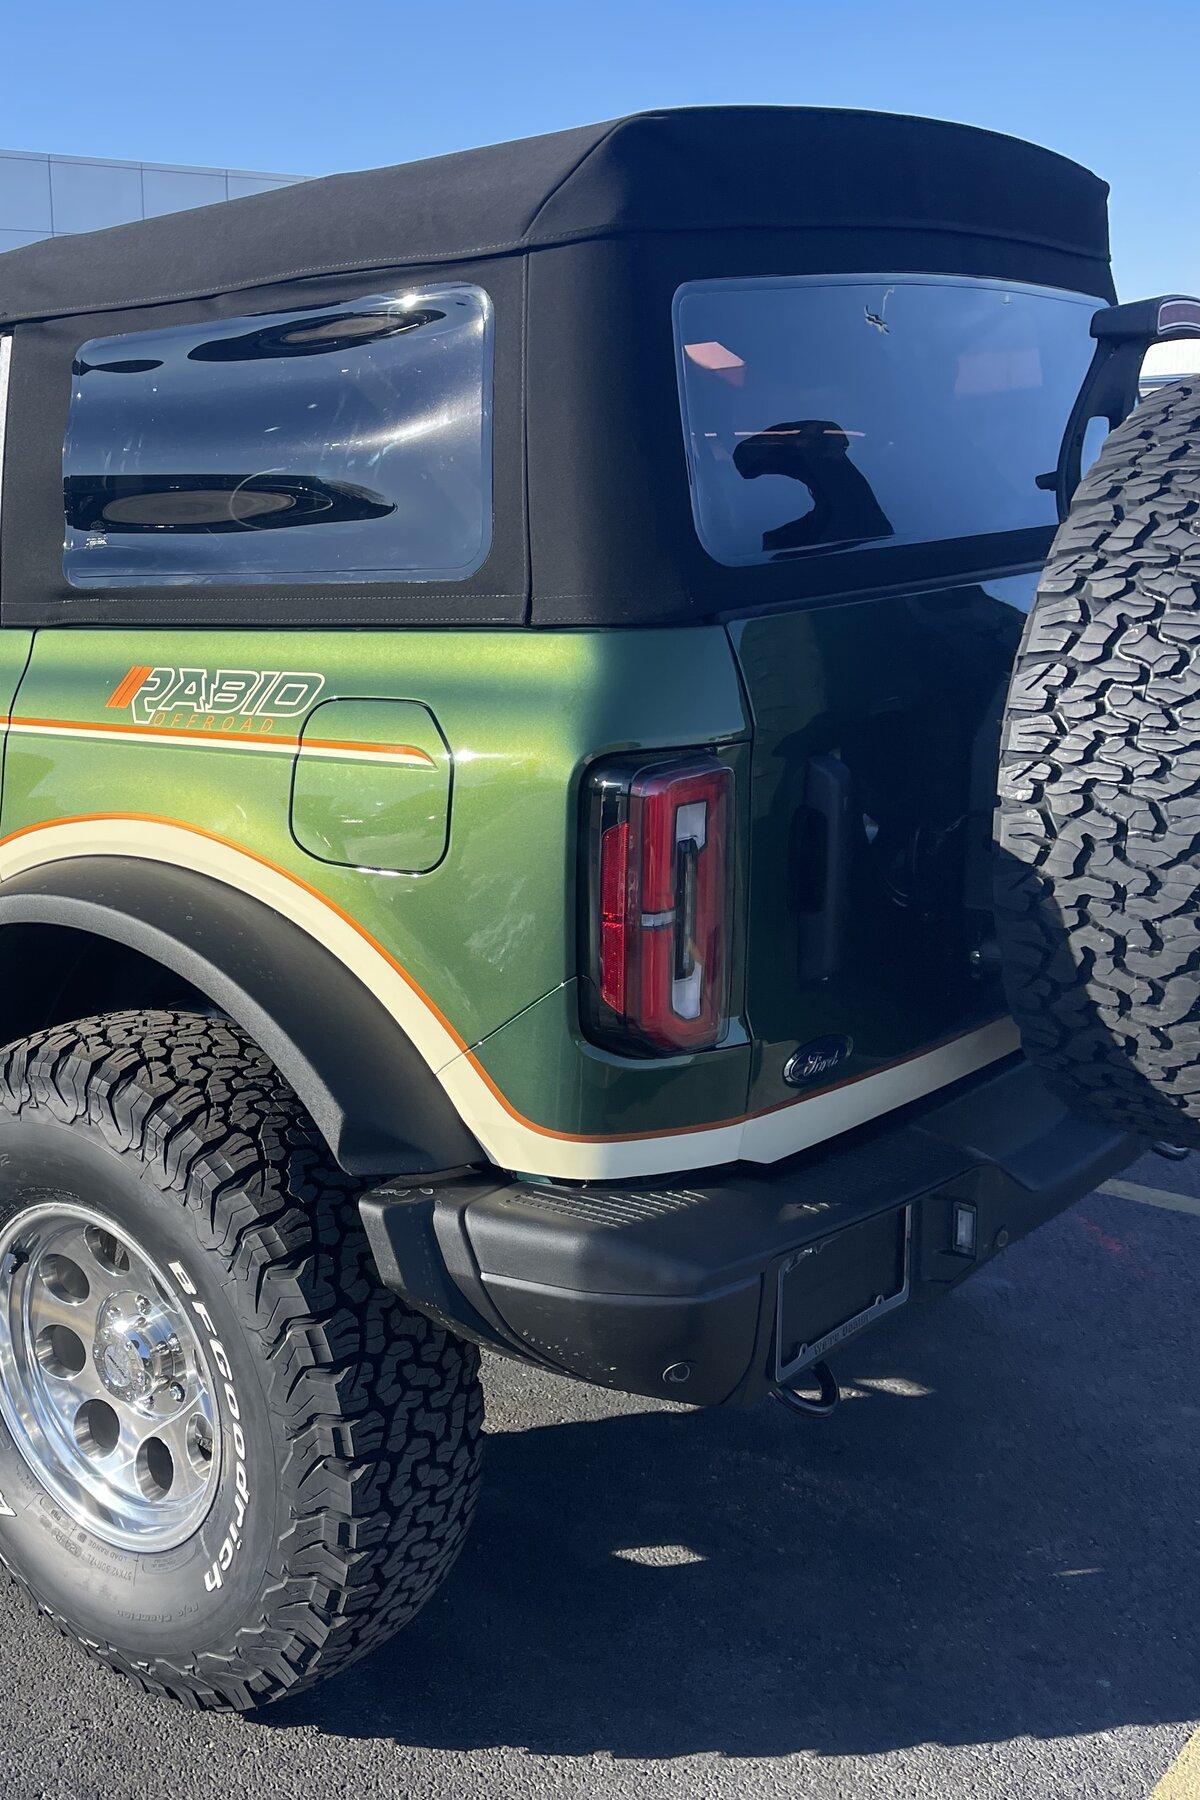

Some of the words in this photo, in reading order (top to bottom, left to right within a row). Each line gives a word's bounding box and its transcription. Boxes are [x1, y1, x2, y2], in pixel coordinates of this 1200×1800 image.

[131, 667, 326, 724] RABID
[154, 712, 275, 733] OFFROAD
[803, 1049, 839, 1077] Ford
